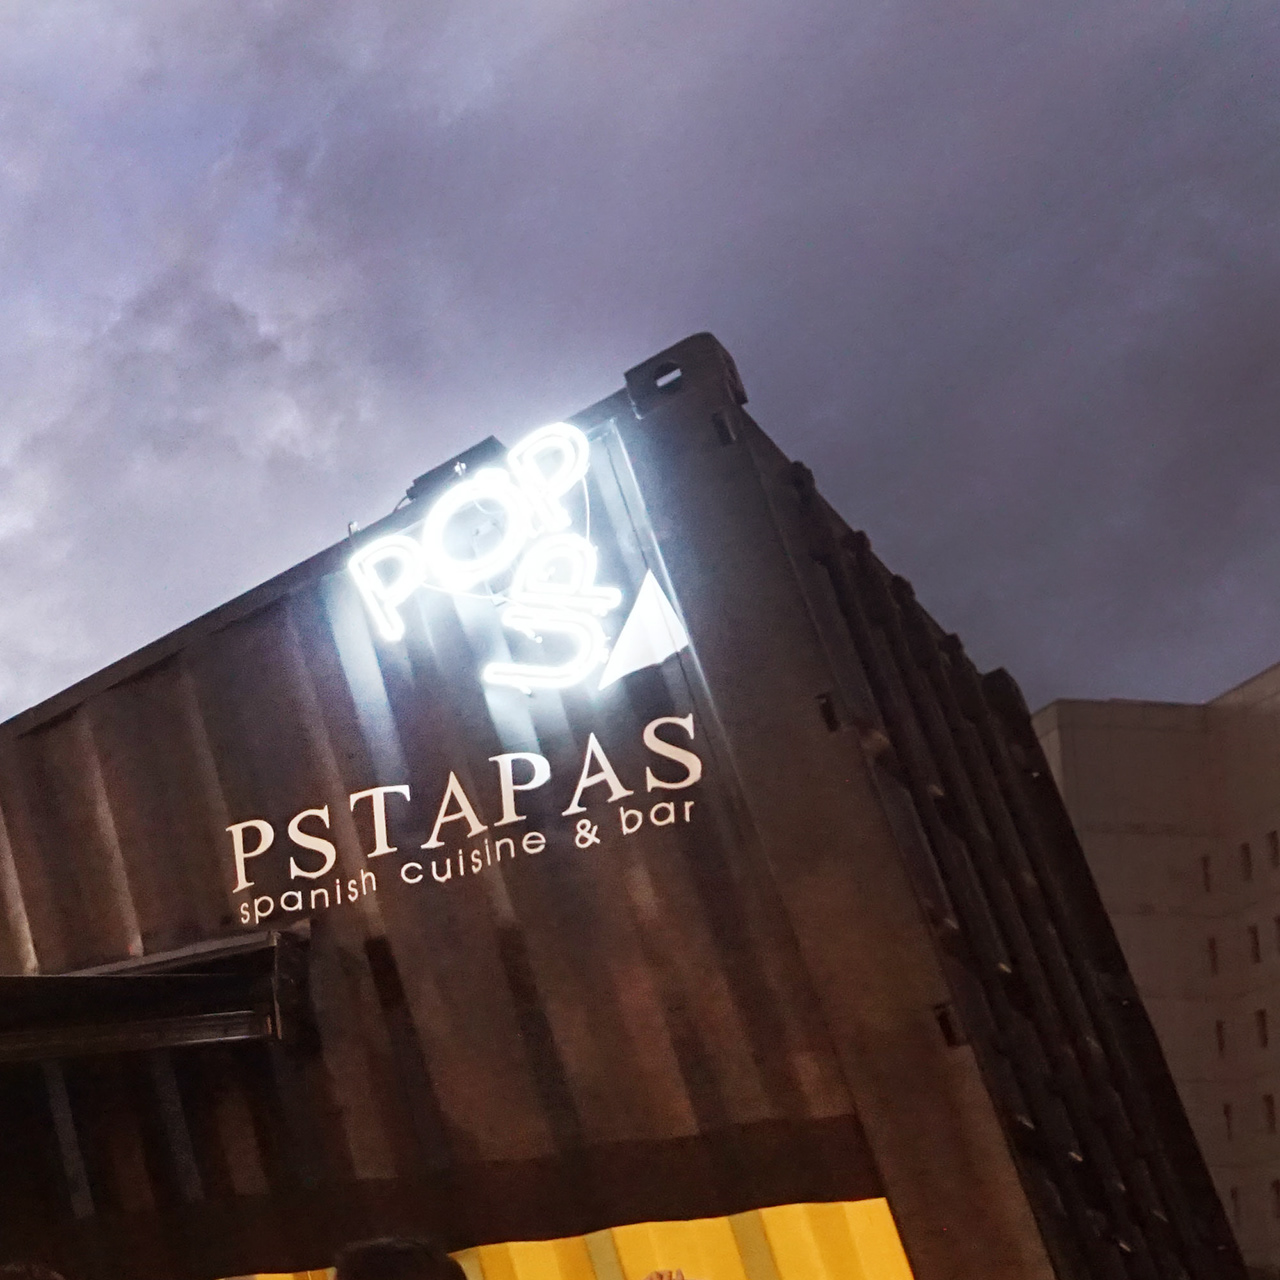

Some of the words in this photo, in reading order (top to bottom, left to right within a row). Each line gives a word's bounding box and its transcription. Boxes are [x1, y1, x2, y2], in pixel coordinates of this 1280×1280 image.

[240, 869, 378, 925] spanish
[400, 830, 546, 884] cuisine
[574, 818, 601, 850] &
[619, 799, 695, 836] bar
